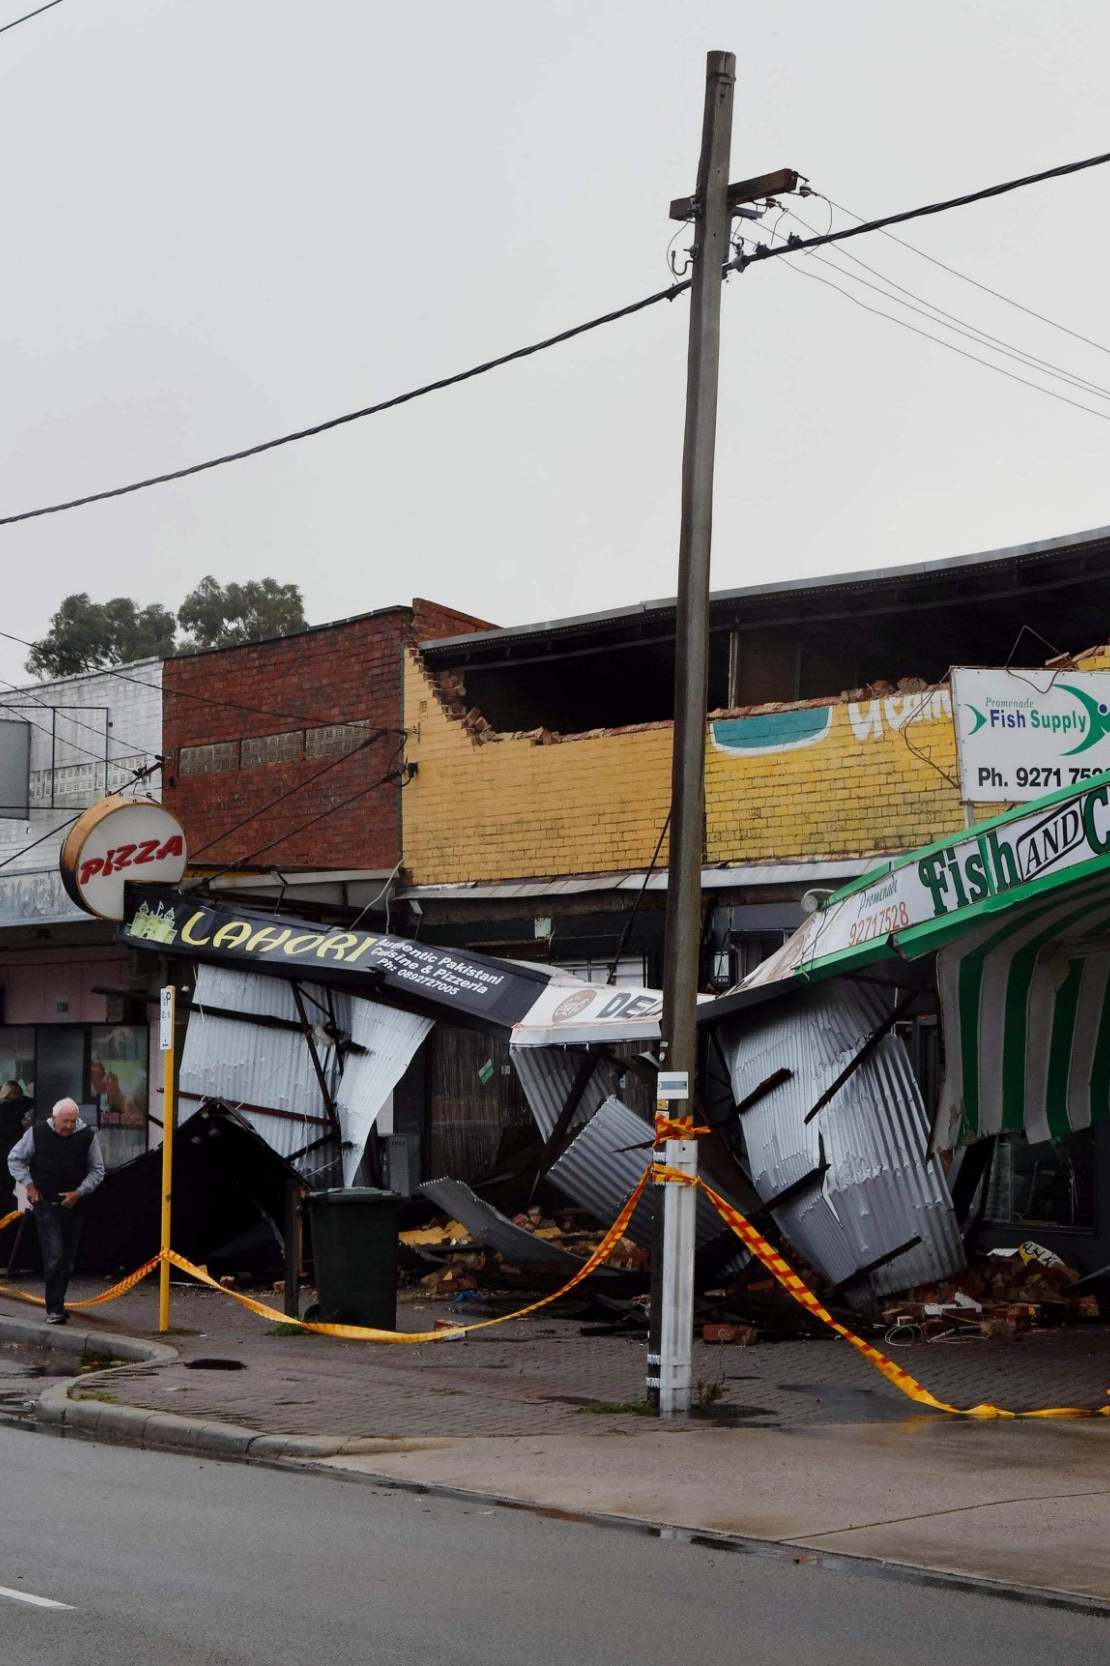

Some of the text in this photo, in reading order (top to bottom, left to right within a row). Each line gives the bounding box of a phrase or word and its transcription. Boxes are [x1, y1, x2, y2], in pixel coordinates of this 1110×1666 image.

[985, 697, 1034, 709] Promenade
[989, 709, 1087, 734] Fish Supply
[977, 767, 1009, 787] Ph.
[1016, 767, 1062, 788] 9271
[80, 835, 183, 885] PIZZA
[918, 831, 1022, 917] Fish
[1025, 810, 1080, 876] AND
[180, 912, 379, 962] LAHORI
[377, 957, 460, 995] Ph: 0892727005
[420, 965, 434, 975] &
[433, 968, 489, 994] Pizzeria
[438, 956, 505, 985] Pakistani
